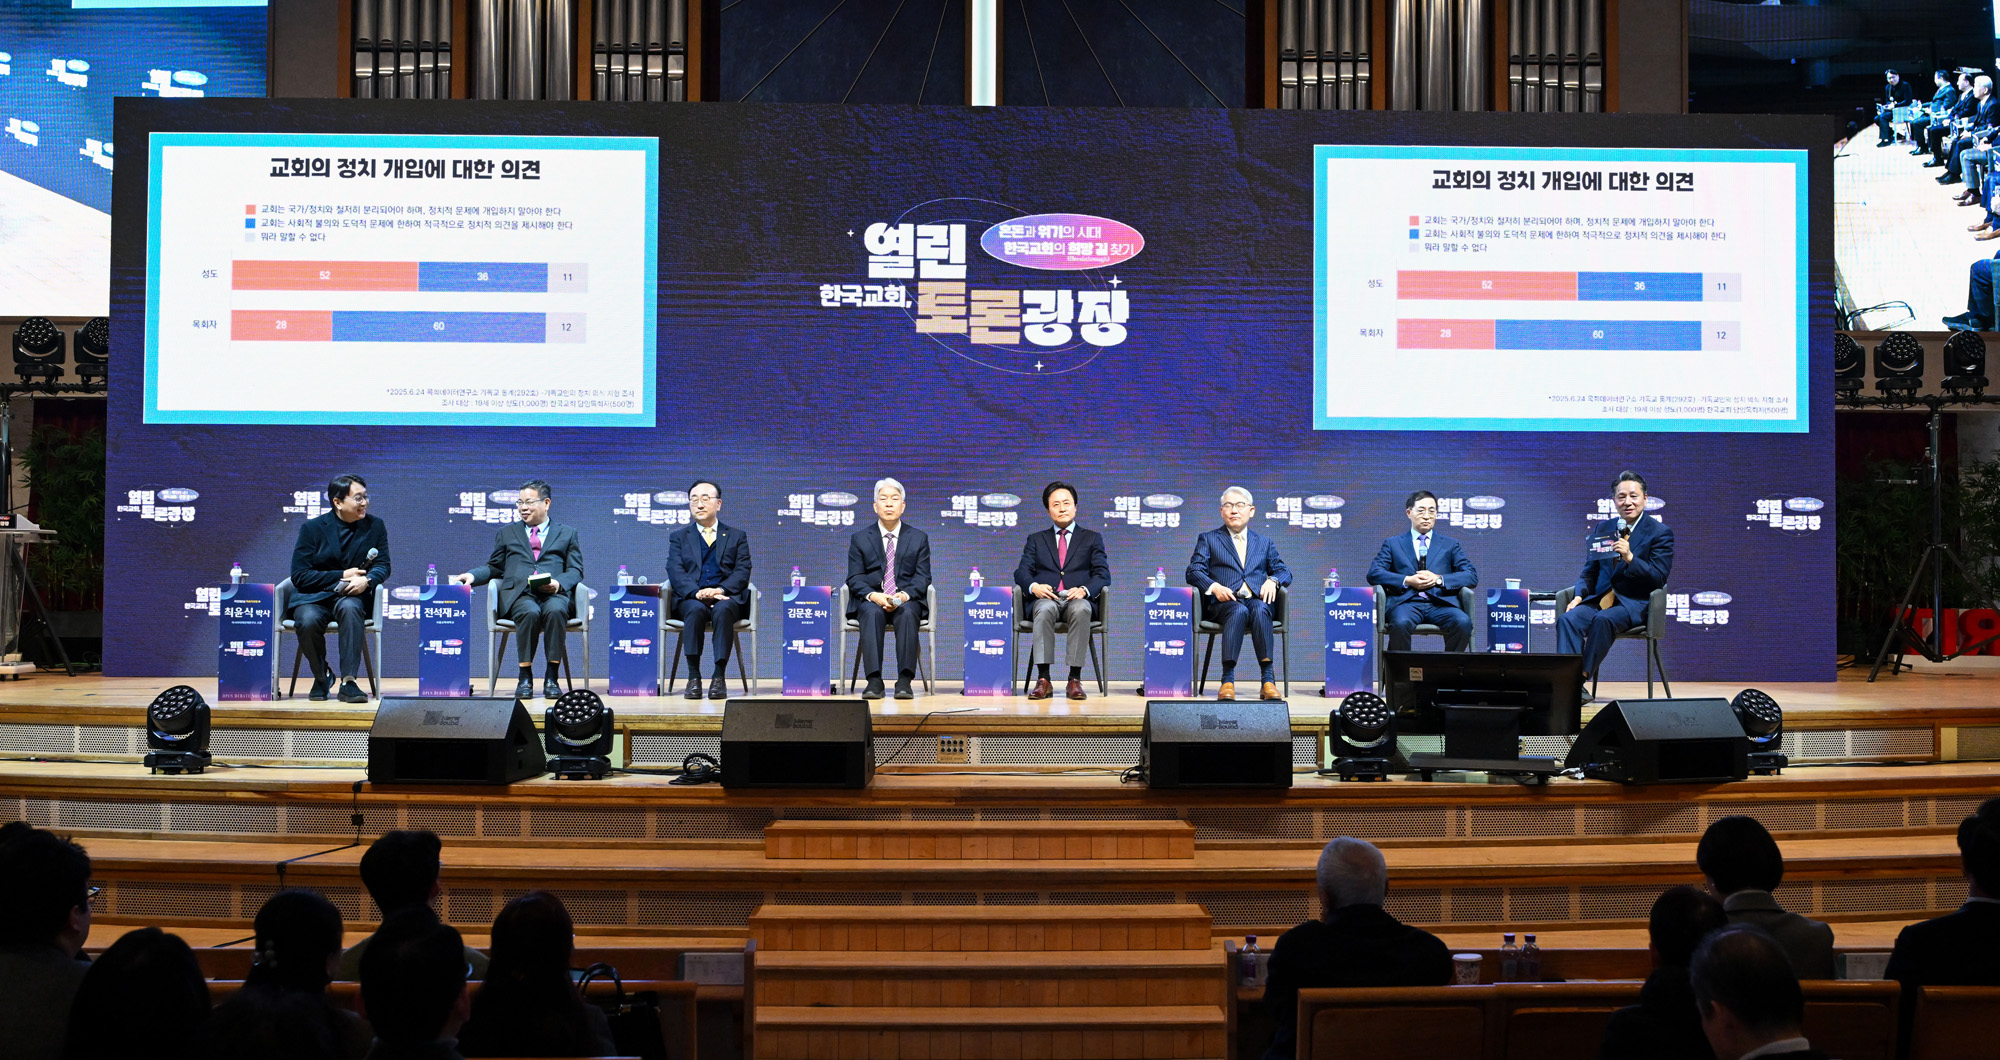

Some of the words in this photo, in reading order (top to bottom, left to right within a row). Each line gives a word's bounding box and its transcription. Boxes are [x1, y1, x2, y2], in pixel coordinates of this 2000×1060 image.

[270, 158, 330, 177] 교회의
[337, 158, 376, 178] 정치
[384, 159, 445, 179] 개입에
[453, 159, 495, 179] 대한
[501, 160, 540, 179] 의견
[1432, 170, 1490, 189] 교회의
[1498, 171, 1534, 190] 정치
[1542, 171, 1602, 191] 개입에
[1609, 171, 1650, 191] 대한
[1656, 172, 1694, 191] 의견
[260, 232, 277, 242] 뭐라
[279, 232, 296, 242] 말할
[298, 232, 307, 242] 수
[309, 232, 326, 242] 없다
[998, 225, 1036, 239] 혼돈과
[1037, 225, 1075, 239] 위기의
[1077, 226, 1102, 239] 시대
[864, 222, 967, 279] 열린
[1004, 241, 1065, 255] 한국교회의
[1067, 241, 1094, 256] 희망
[1095, 241, 1108, 256] 길
[1110, 243, 1134, 256] 찾기
[1424, 242, 1440, 252] 뭐라
[1442, 242, 1459, 253] 말할
[1461, 243, 1469, 252] 수
[1471, 243, 1488, 253] 없다
[201, 269, 217, 278] 성도
[319, 270, 331, 280] 52
[476, 271, 489, 282] 36
[563, 273, 572, 281] 11
[1367, 279, 1382, 289] 성도
[1481, 279, 1493, 290] 52
[1634, 281, 1646, 291] 36
[1717, 282, 1726, 291] 11
[819, 284, 912, 309] 한국교회,
[916, 281, 1130, 347] 토론광장
[192, 319, 217, 329] 목회자
[275, 319, 288, 330] 28
[432, 321, 445, 331] 60
[561, 322, 572, 332] 12
[1360, 328, 1384, 338] 목회자
[1440, 328, 1452, 338] 28
[1592, 329, 1605, 339] 60
[1716, 331, 1727, 340] 12
[128, 490, 155, 505] 열린
[294, 491, 321, 506] 열린
[460, 492, 486, 507] 열린
[624, 493, 651, 508] 열린
[789, 494, 815, 509] 열린
[952, 495, 978, 510] 열린
[1114, 496, 1140, 511] 열린
[1276, 497, 1302, 512] 열린
[1437, 498, 1463, 512] 열린
[1756, 499, 1782, 514] 열린
[141, 505, 195, 521] 토론광장
[637, 508, 691, 524] 토론광장
[801, 509, 855, 525] 토론광장
[964, 510, 1018, 526] 토론광장
[1127, 511, 1180, 527] 토론광장
[1289, 512, 1342, 528] 토론광장
[1450, 513, 1503, 529] 토론광장
[1769, 514, 1821, 530] 토론광장
[196, 587, 221, 602] 열린
[1666, 594, 1689, 608] 열린
[224, 607, 254, 618] 최윤식
[255, 609, 271, 618] 박사
[424, 607, 452, 618] 전석재
[453, 609, 467, 618] 교수
[613, 607, 640, 619] 장동민
[641, 609, 655, 618] 교수
[787, 608, 813, 619] 김문훈
[814, 609, 828, 618] 목사
[968, 608, 994, 619] 박성민
[995, 610, 1009, 619] 목사
[1149, 609, 1174, 620] 한기채
[1175, 611, 1189, 620] 목사
[1329, 609, 1356, 620] 이상학
[1356, 611, 1370, 620] 목사
[1491, 611, 1513, 622] 이기용
[1514, 613, 1526, 622] 목사
[1676, 608, 1729, 624] 토론광장
